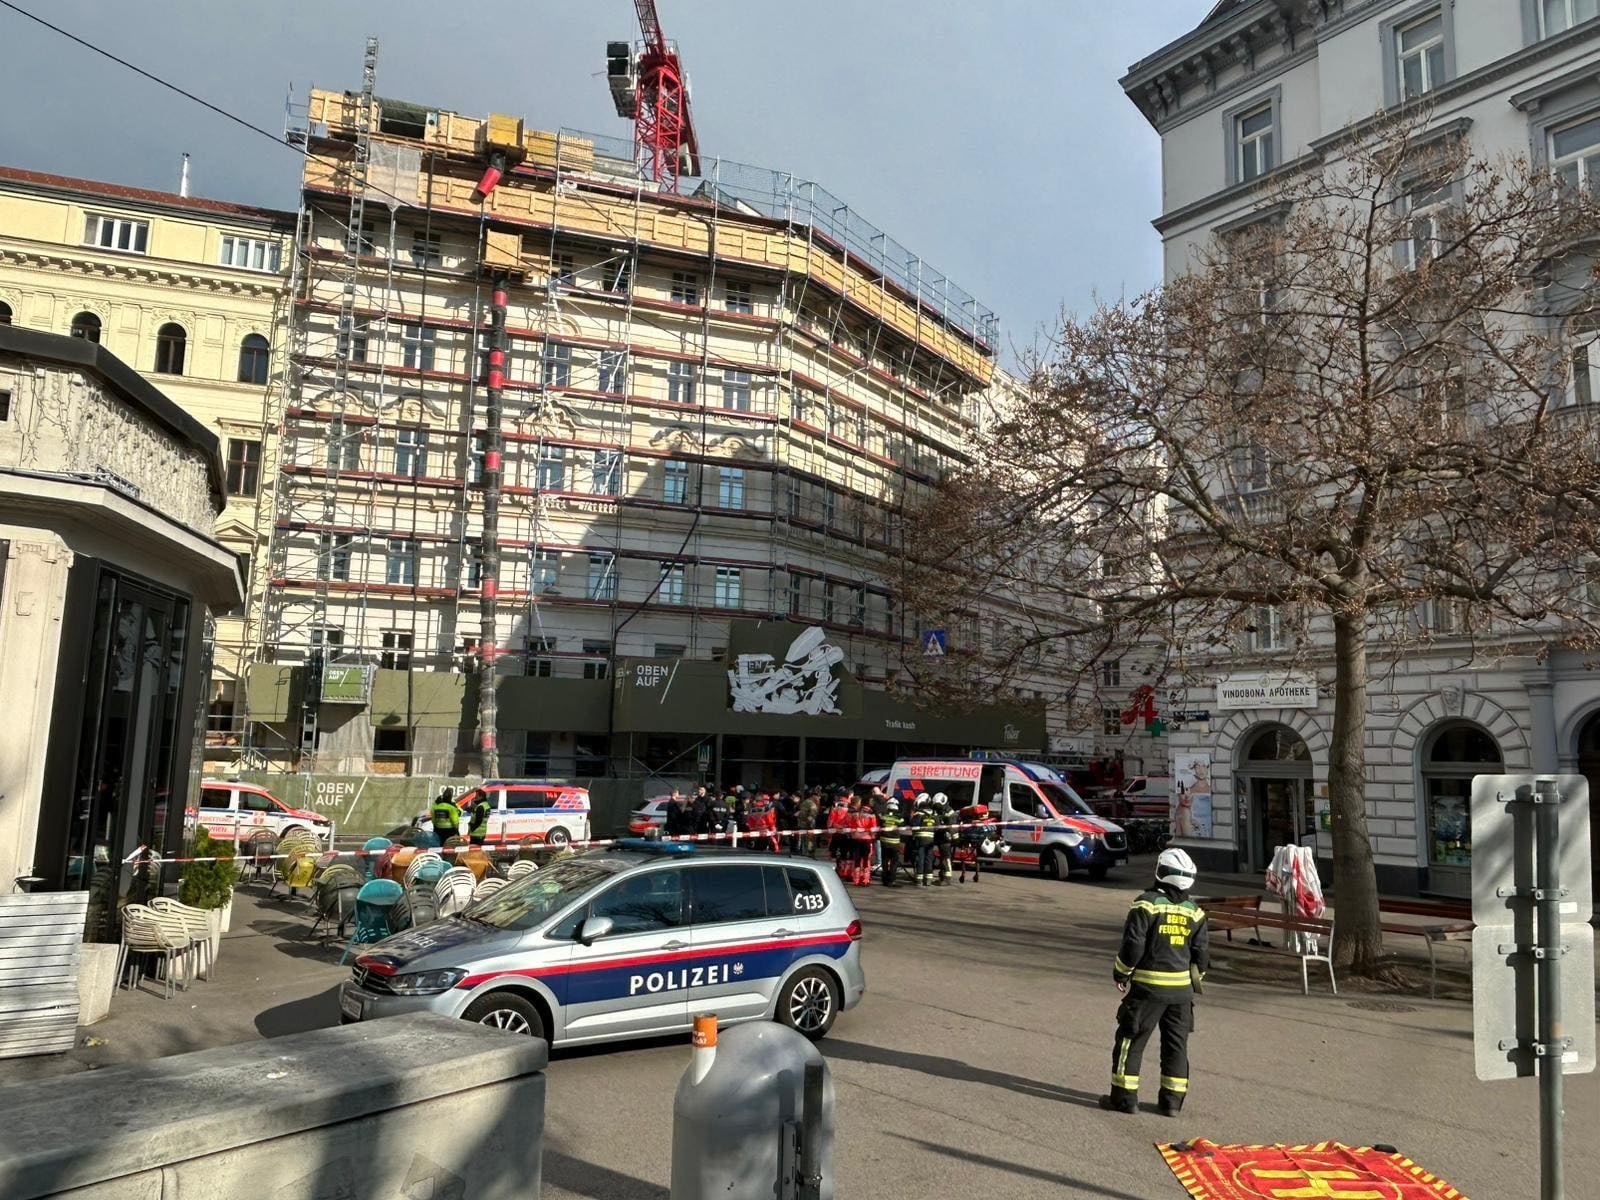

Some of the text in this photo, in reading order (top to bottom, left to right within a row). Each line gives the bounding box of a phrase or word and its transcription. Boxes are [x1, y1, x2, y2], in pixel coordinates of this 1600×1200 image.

[636, 665, 669, 677] OBEN
[635, 676, 660, 687] AUF
[1222, 687, 1310, 699] VINDOBONA APOTHEKE
[317, 782, 355, 794] OBEN
[315, 794, 344, 806] AUF
[803, 894, 824, 910] 133
[629, 963, 729, 995] POLIZEI
